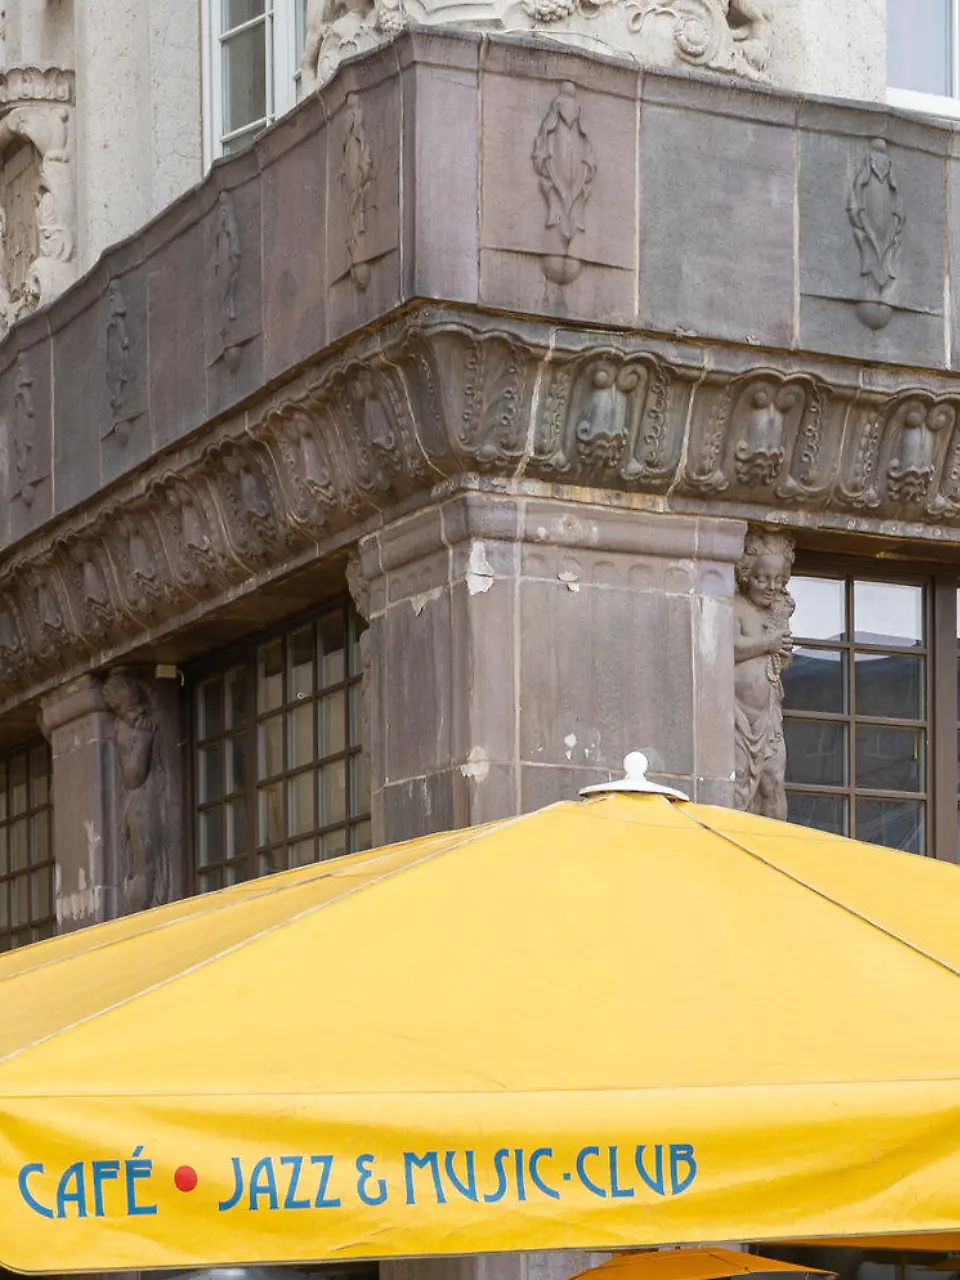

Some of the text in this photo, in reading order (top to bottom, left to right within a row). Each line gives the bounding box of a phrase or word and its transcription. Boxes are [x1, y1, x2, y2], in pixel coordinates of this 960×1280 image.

[18, 1146, 158, 1218] CAFÉ
[218, 1154, 342, 1211] JAZZ
[356, 1154, 388, 1207] &
